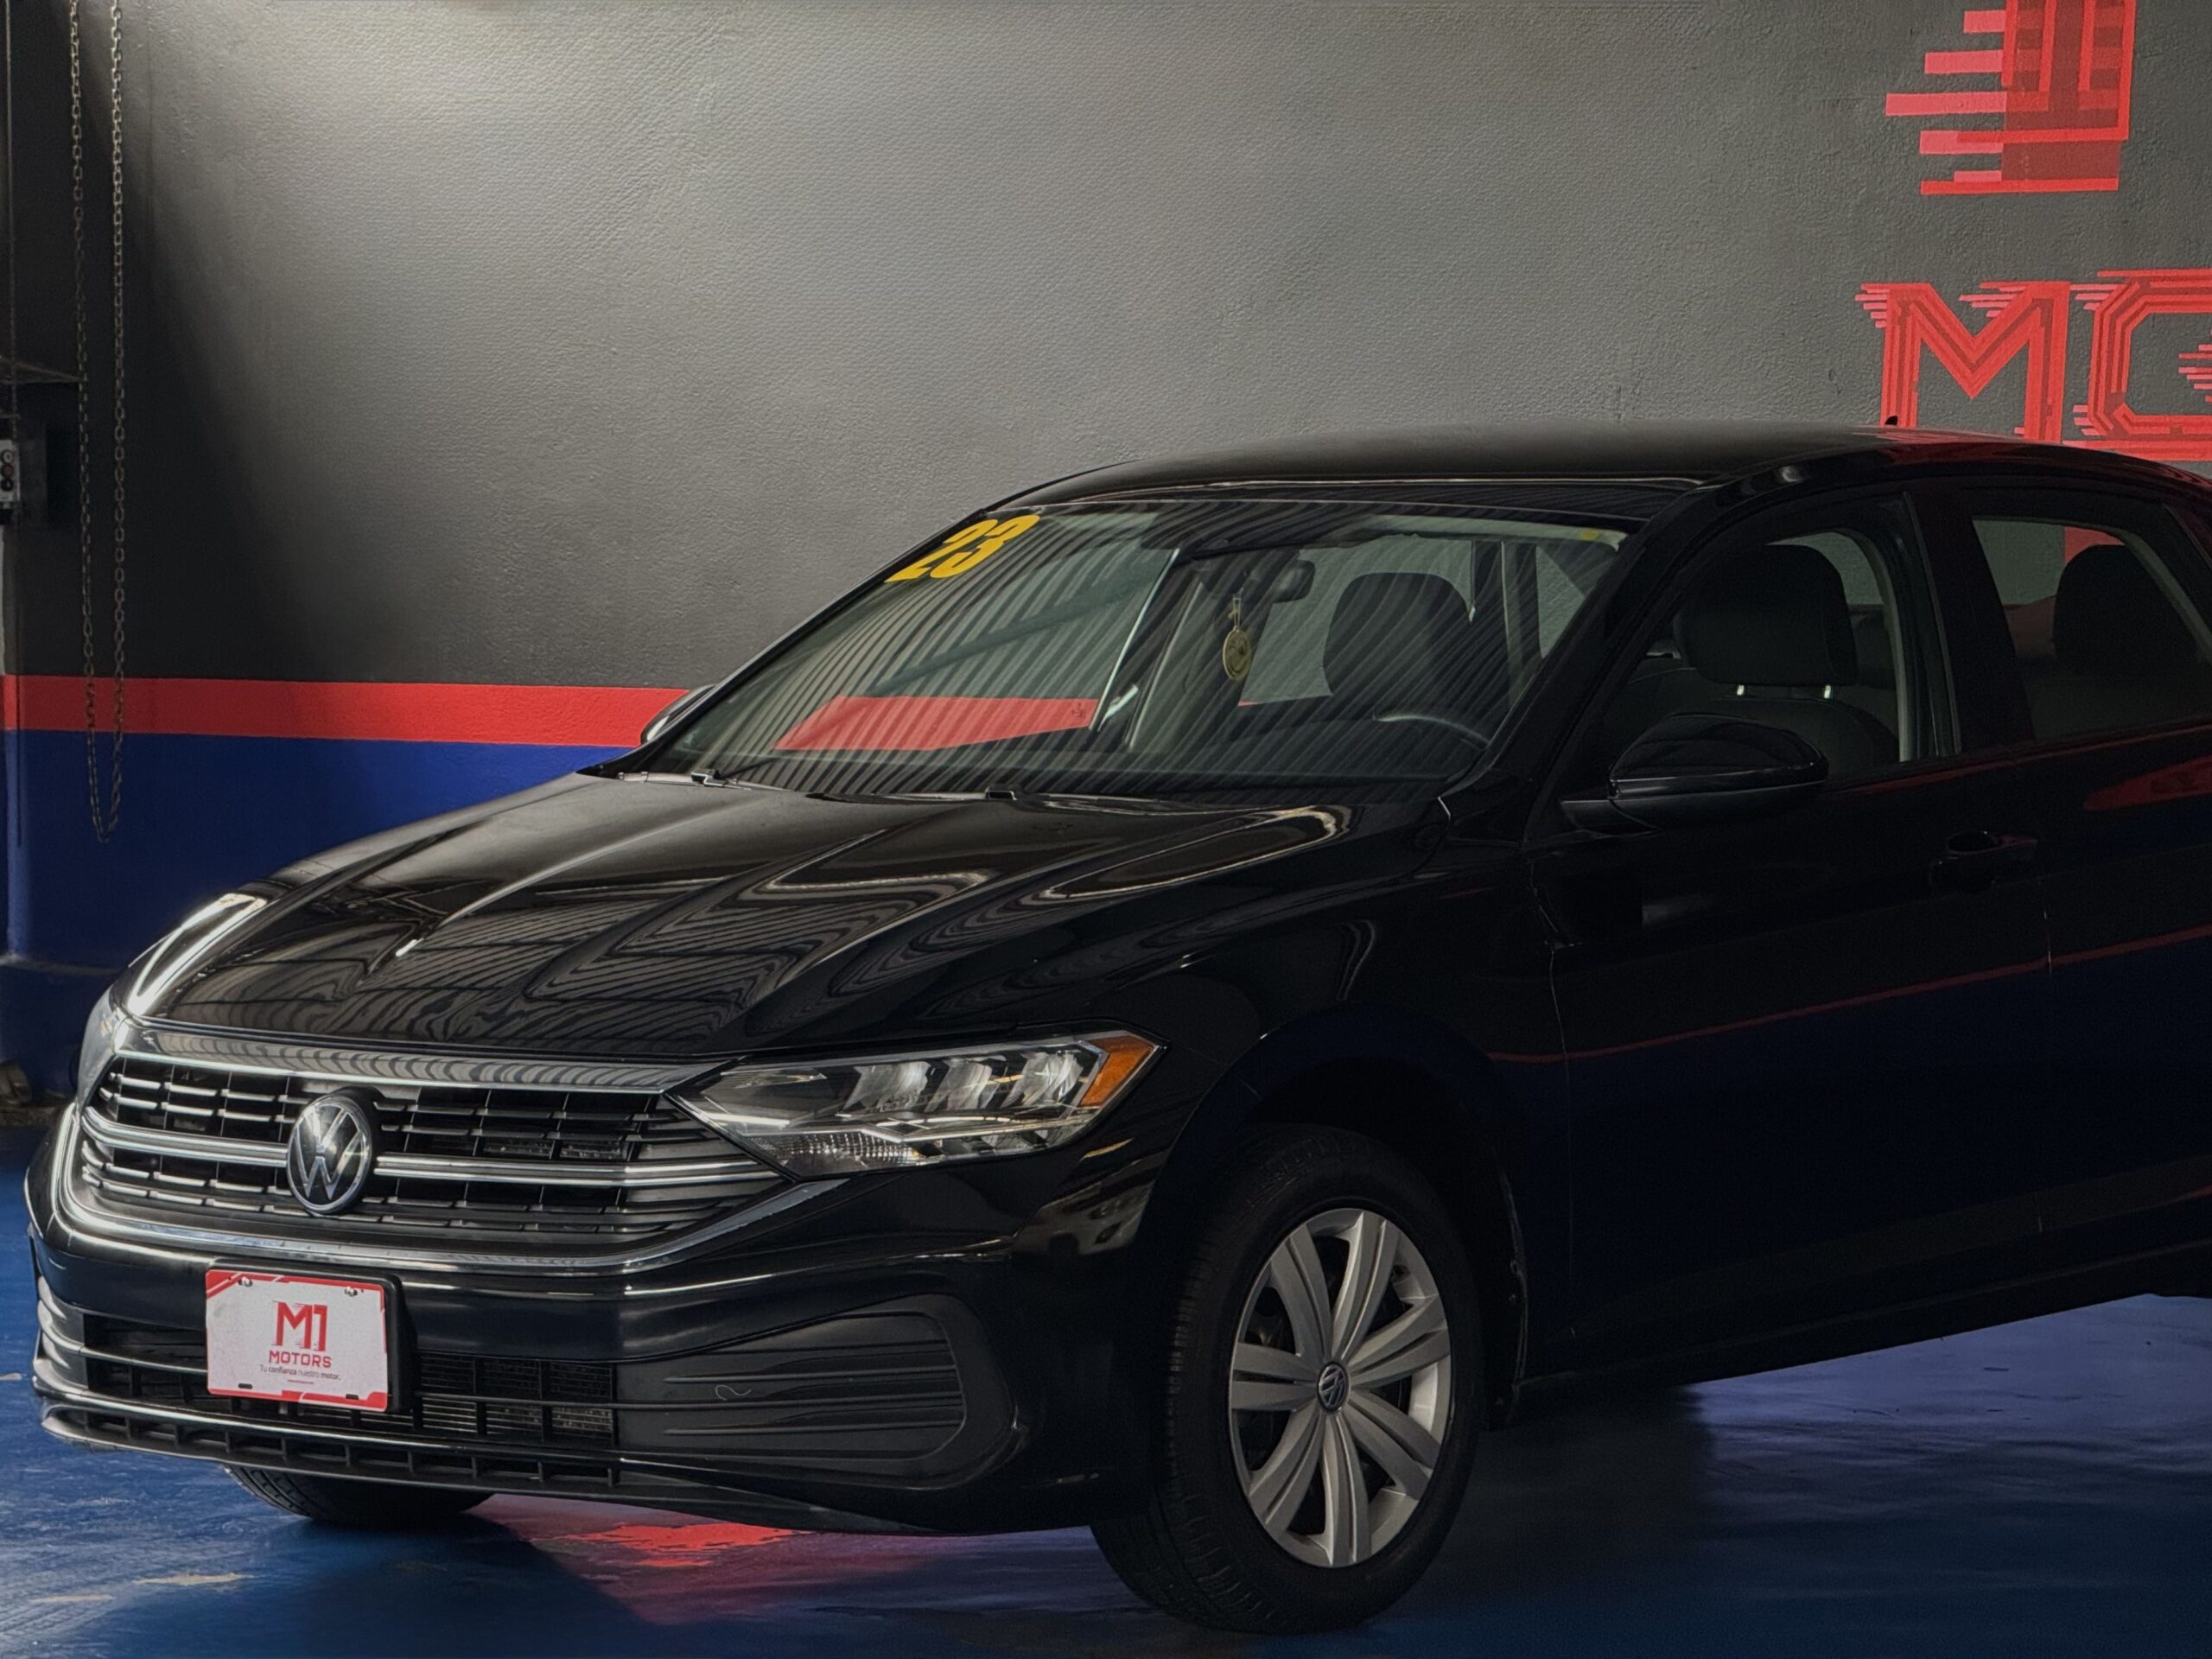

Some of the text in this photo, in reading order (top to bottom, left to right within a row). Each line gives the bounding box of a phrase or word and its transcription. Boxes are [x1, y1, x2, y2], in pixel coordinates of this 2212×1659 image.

[884, 515, 1040, 583] 23
[275, 1301, 327, 1351] M1
[268, 1366, 296, 1376] confianza
[269, 1350, 332, 1369] MOTORS
